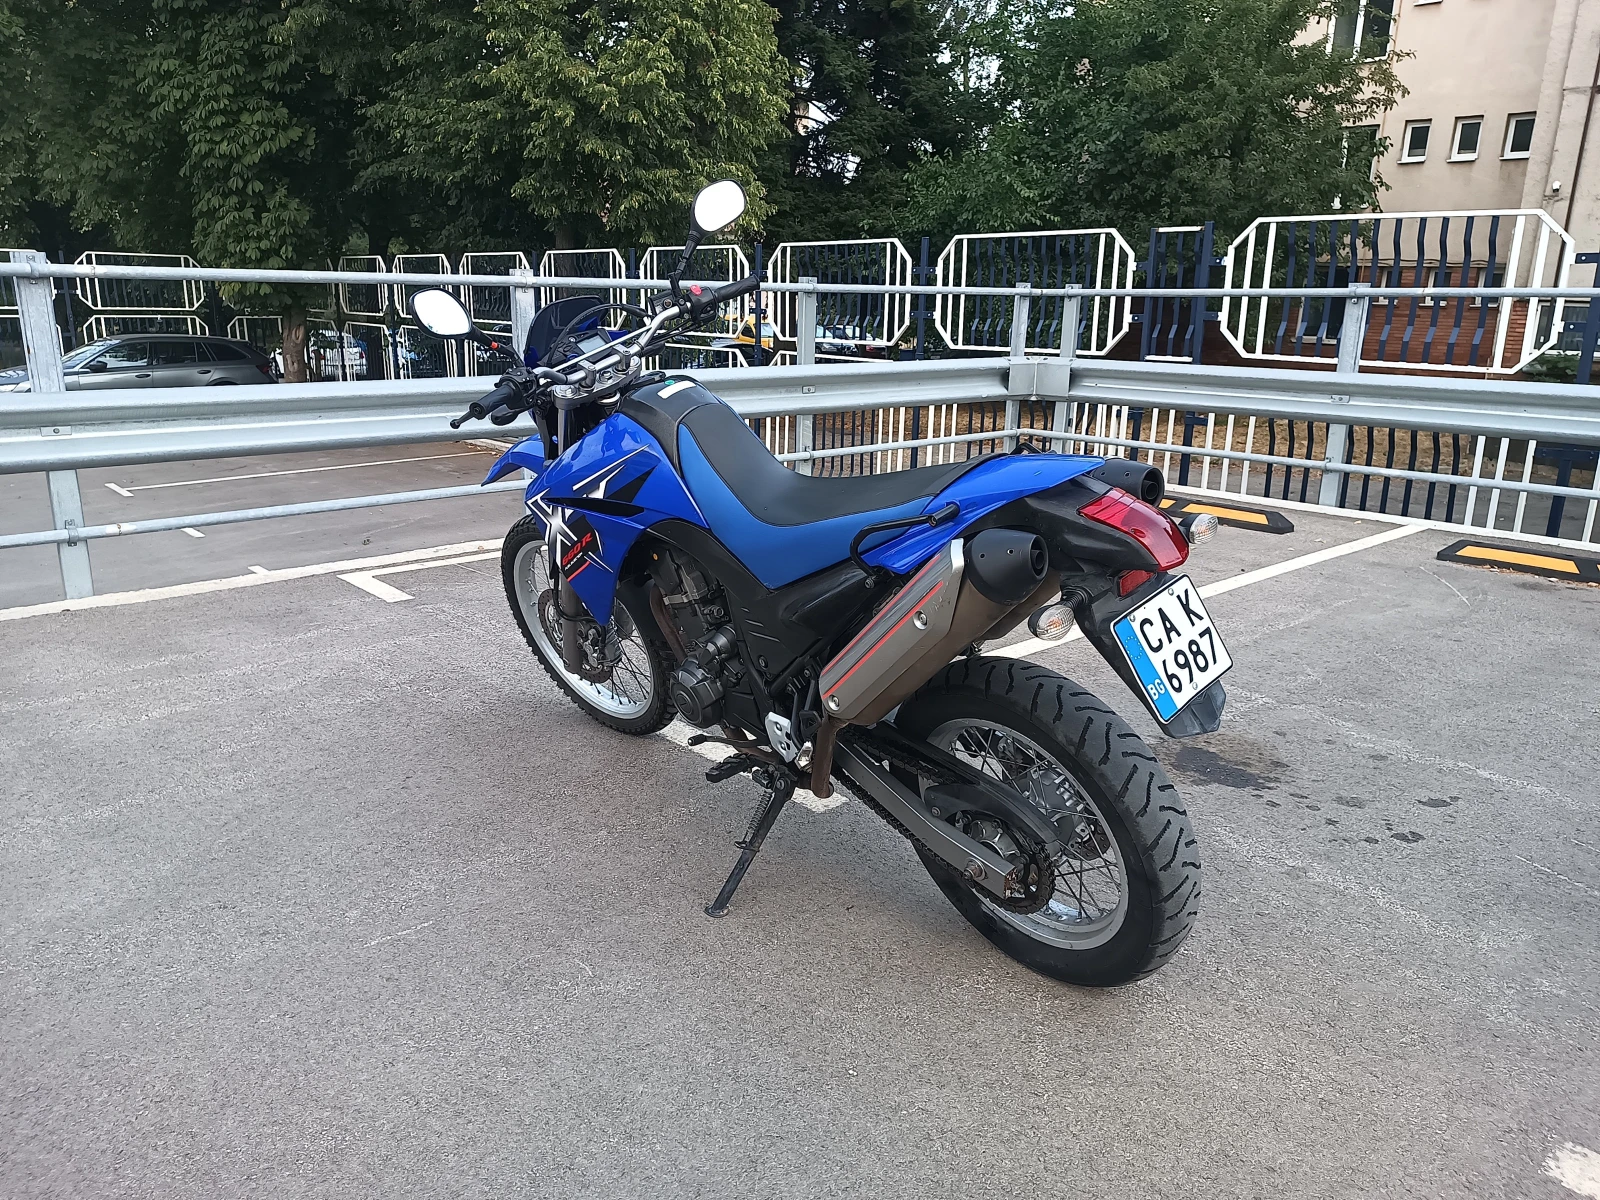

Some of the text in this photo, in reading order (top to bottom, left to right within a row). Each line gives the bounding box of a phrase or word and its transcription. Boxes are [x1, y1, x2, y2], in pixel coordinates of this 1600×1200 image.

[1139, 588, 1204, 653] CA K
[1147, 679, 1166, 701] BG
[1162, 627, 1217, 693] 6987
